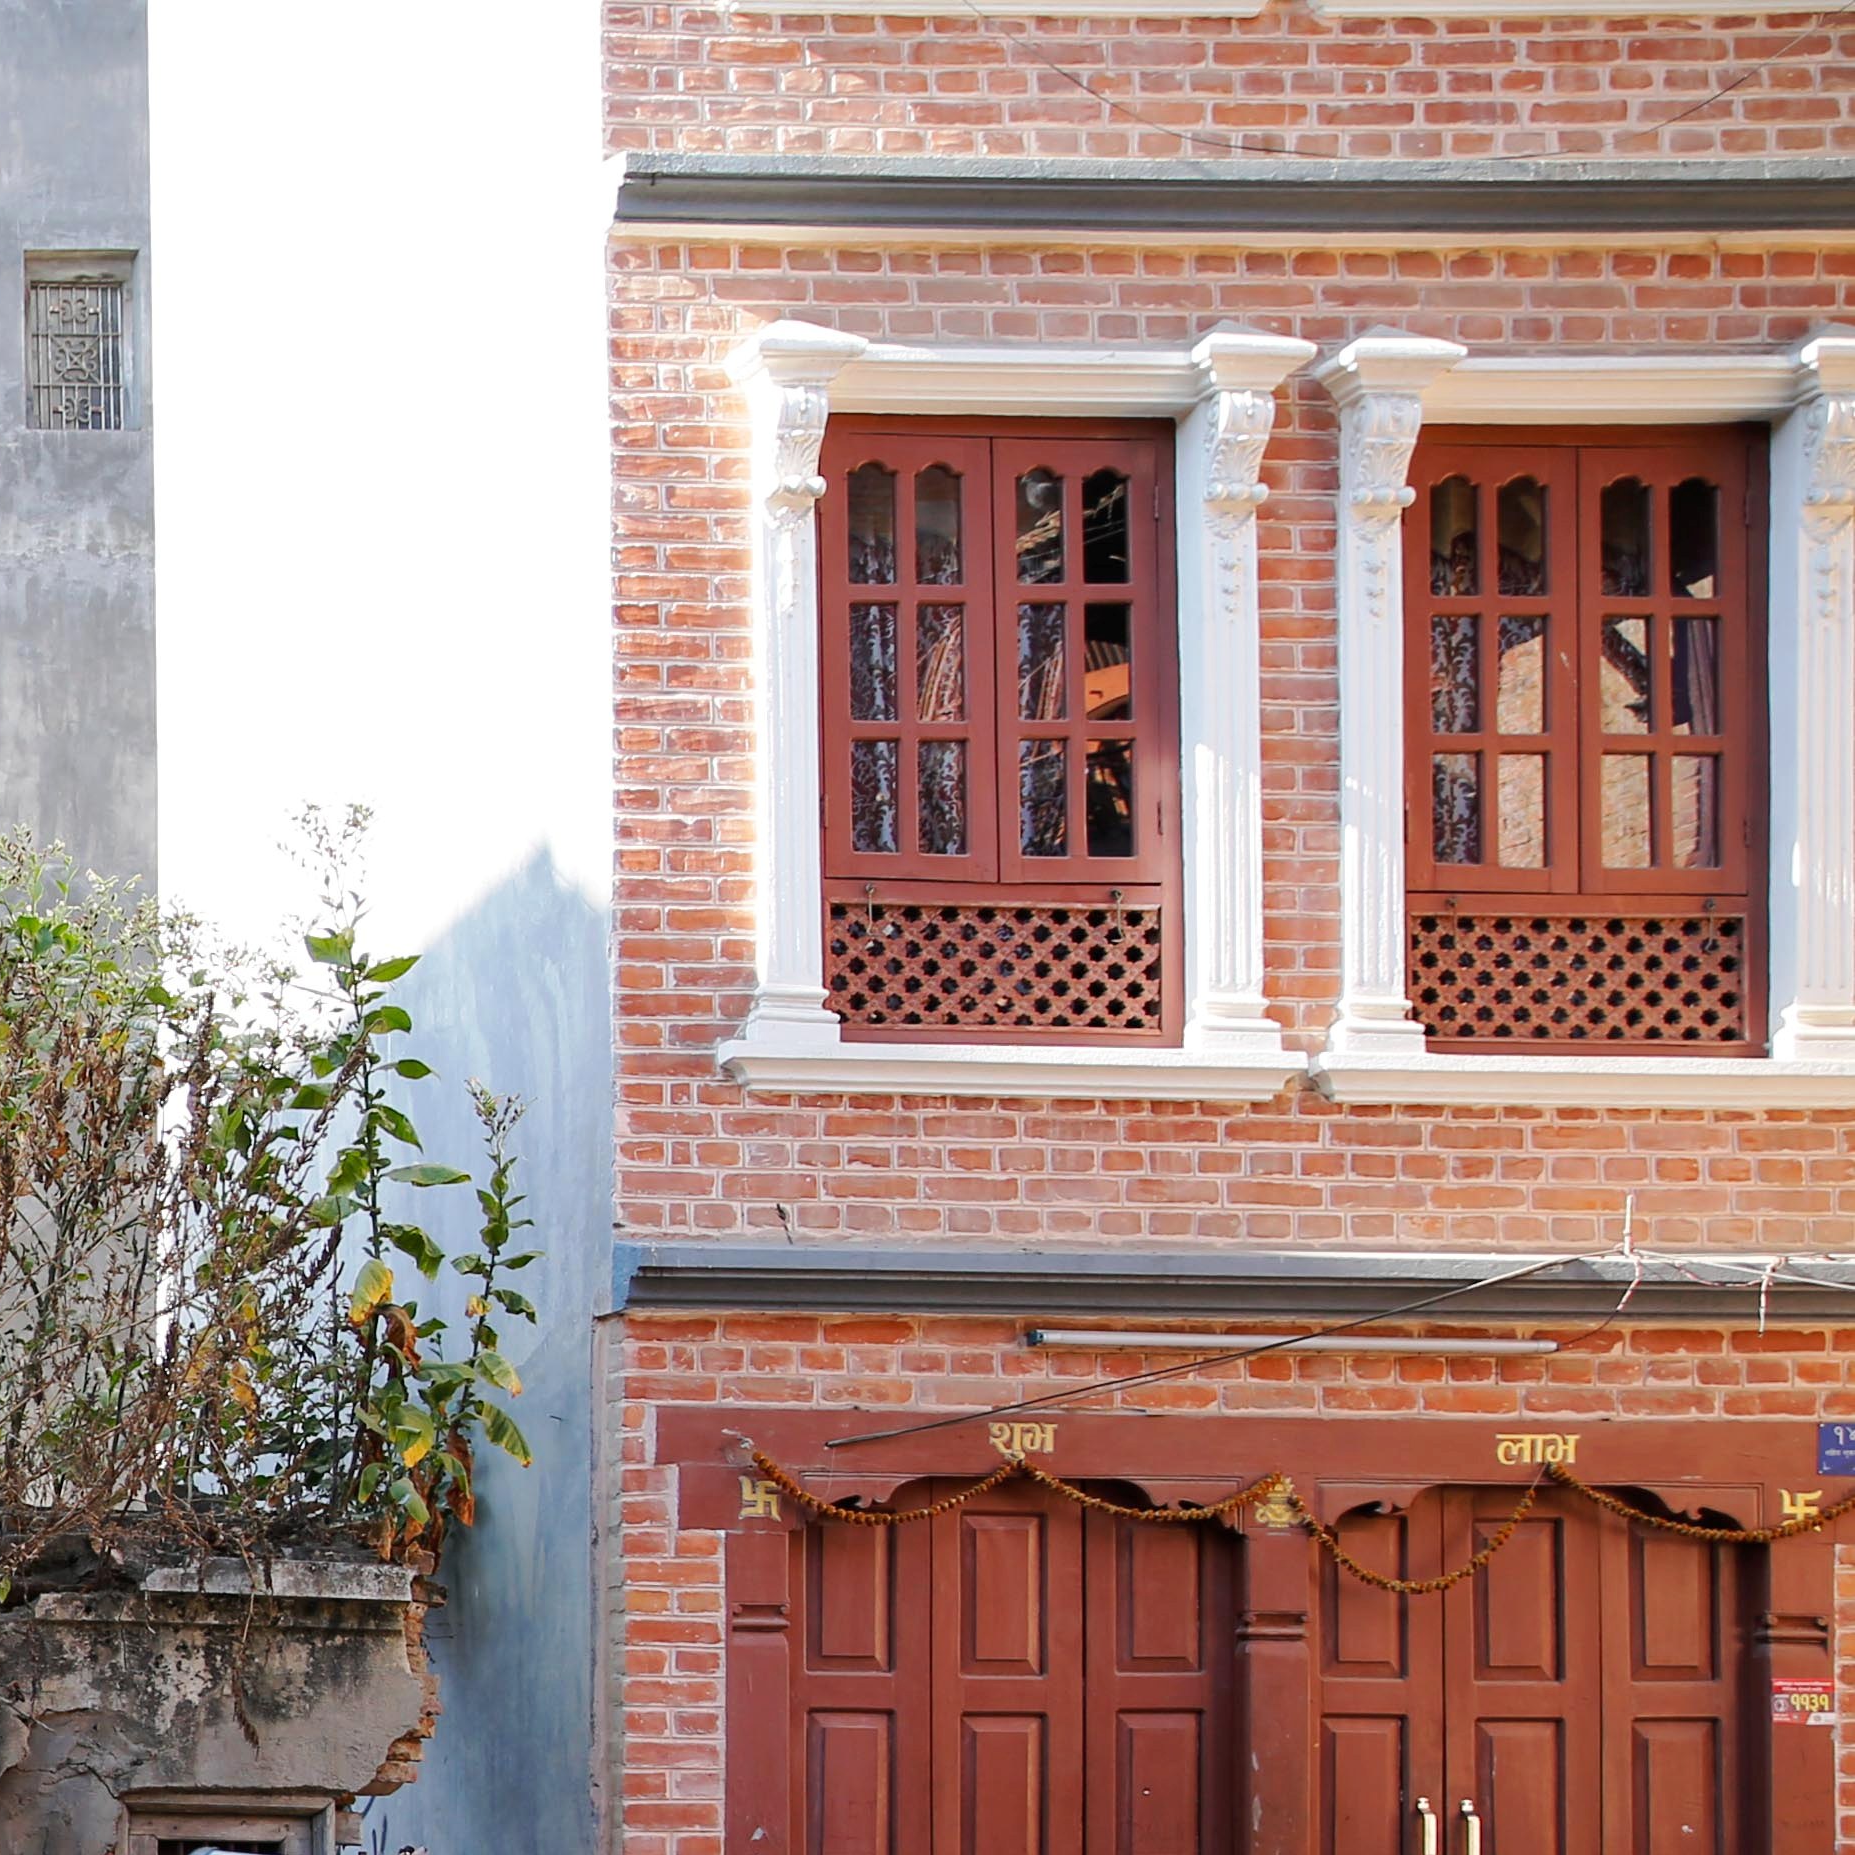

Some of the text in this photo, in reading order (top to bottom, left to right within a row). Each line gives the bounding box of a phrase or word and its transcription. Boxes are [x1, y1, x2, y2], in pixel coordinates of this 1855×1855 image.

[989, 1419, 1058, 1457] शुभ
[1497, 1430, 1579, 1466] लाभ
[1790, 1693, 1829, 1712] ११३१
